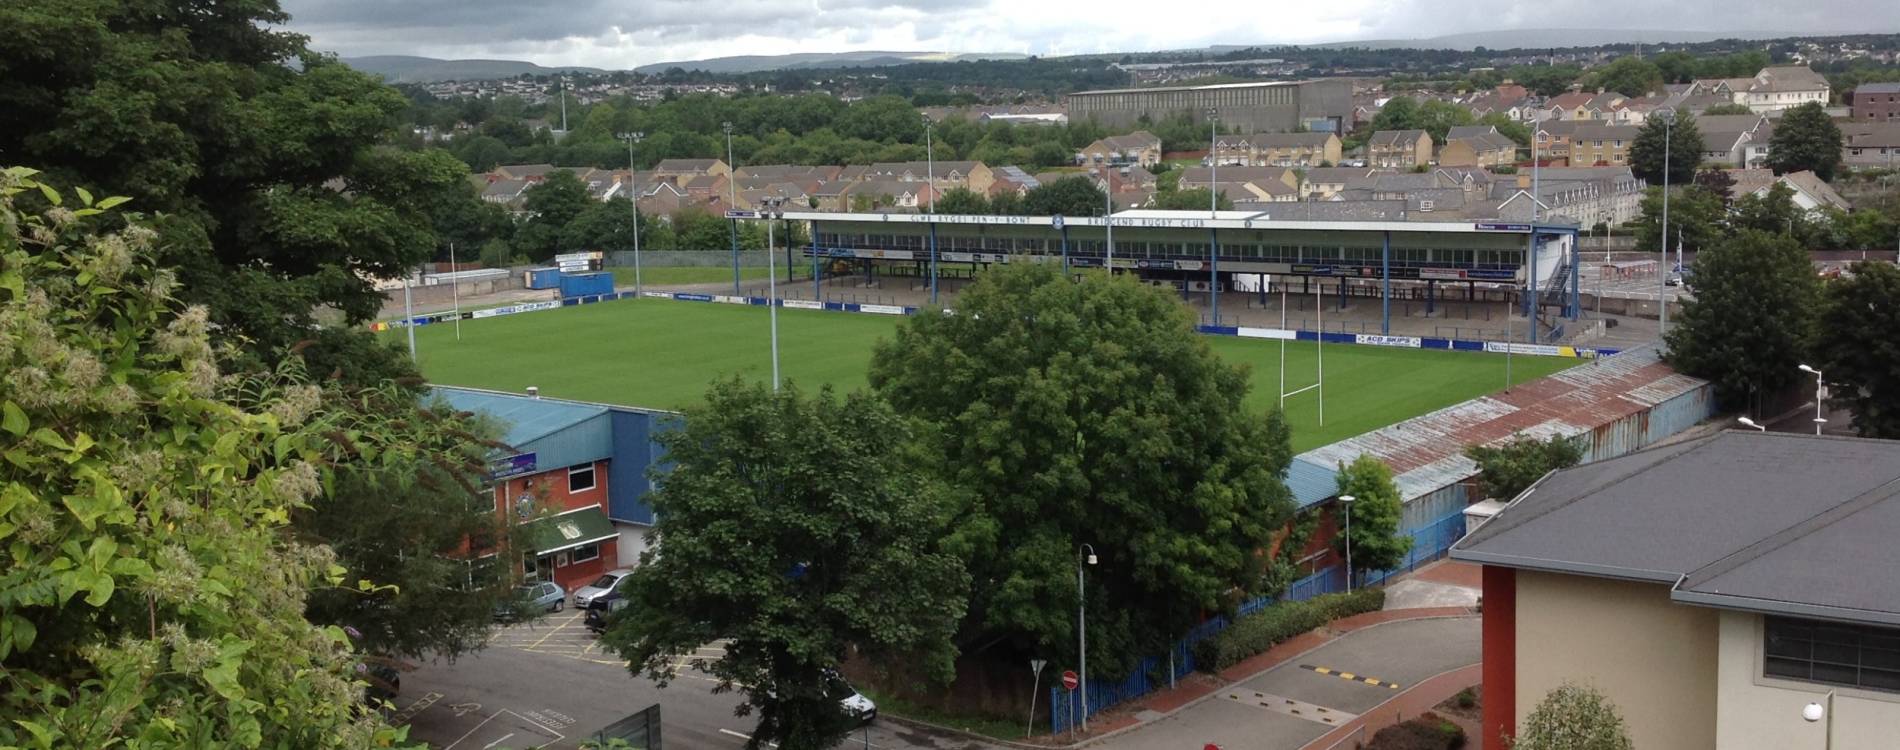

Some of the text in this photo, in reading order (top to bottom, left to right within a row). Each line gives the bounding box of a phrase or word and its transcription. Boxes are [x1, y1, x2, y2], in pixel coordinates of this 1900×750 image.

[1087, 217, 1205, 226] BRIDGEND RUGBY CLUB
